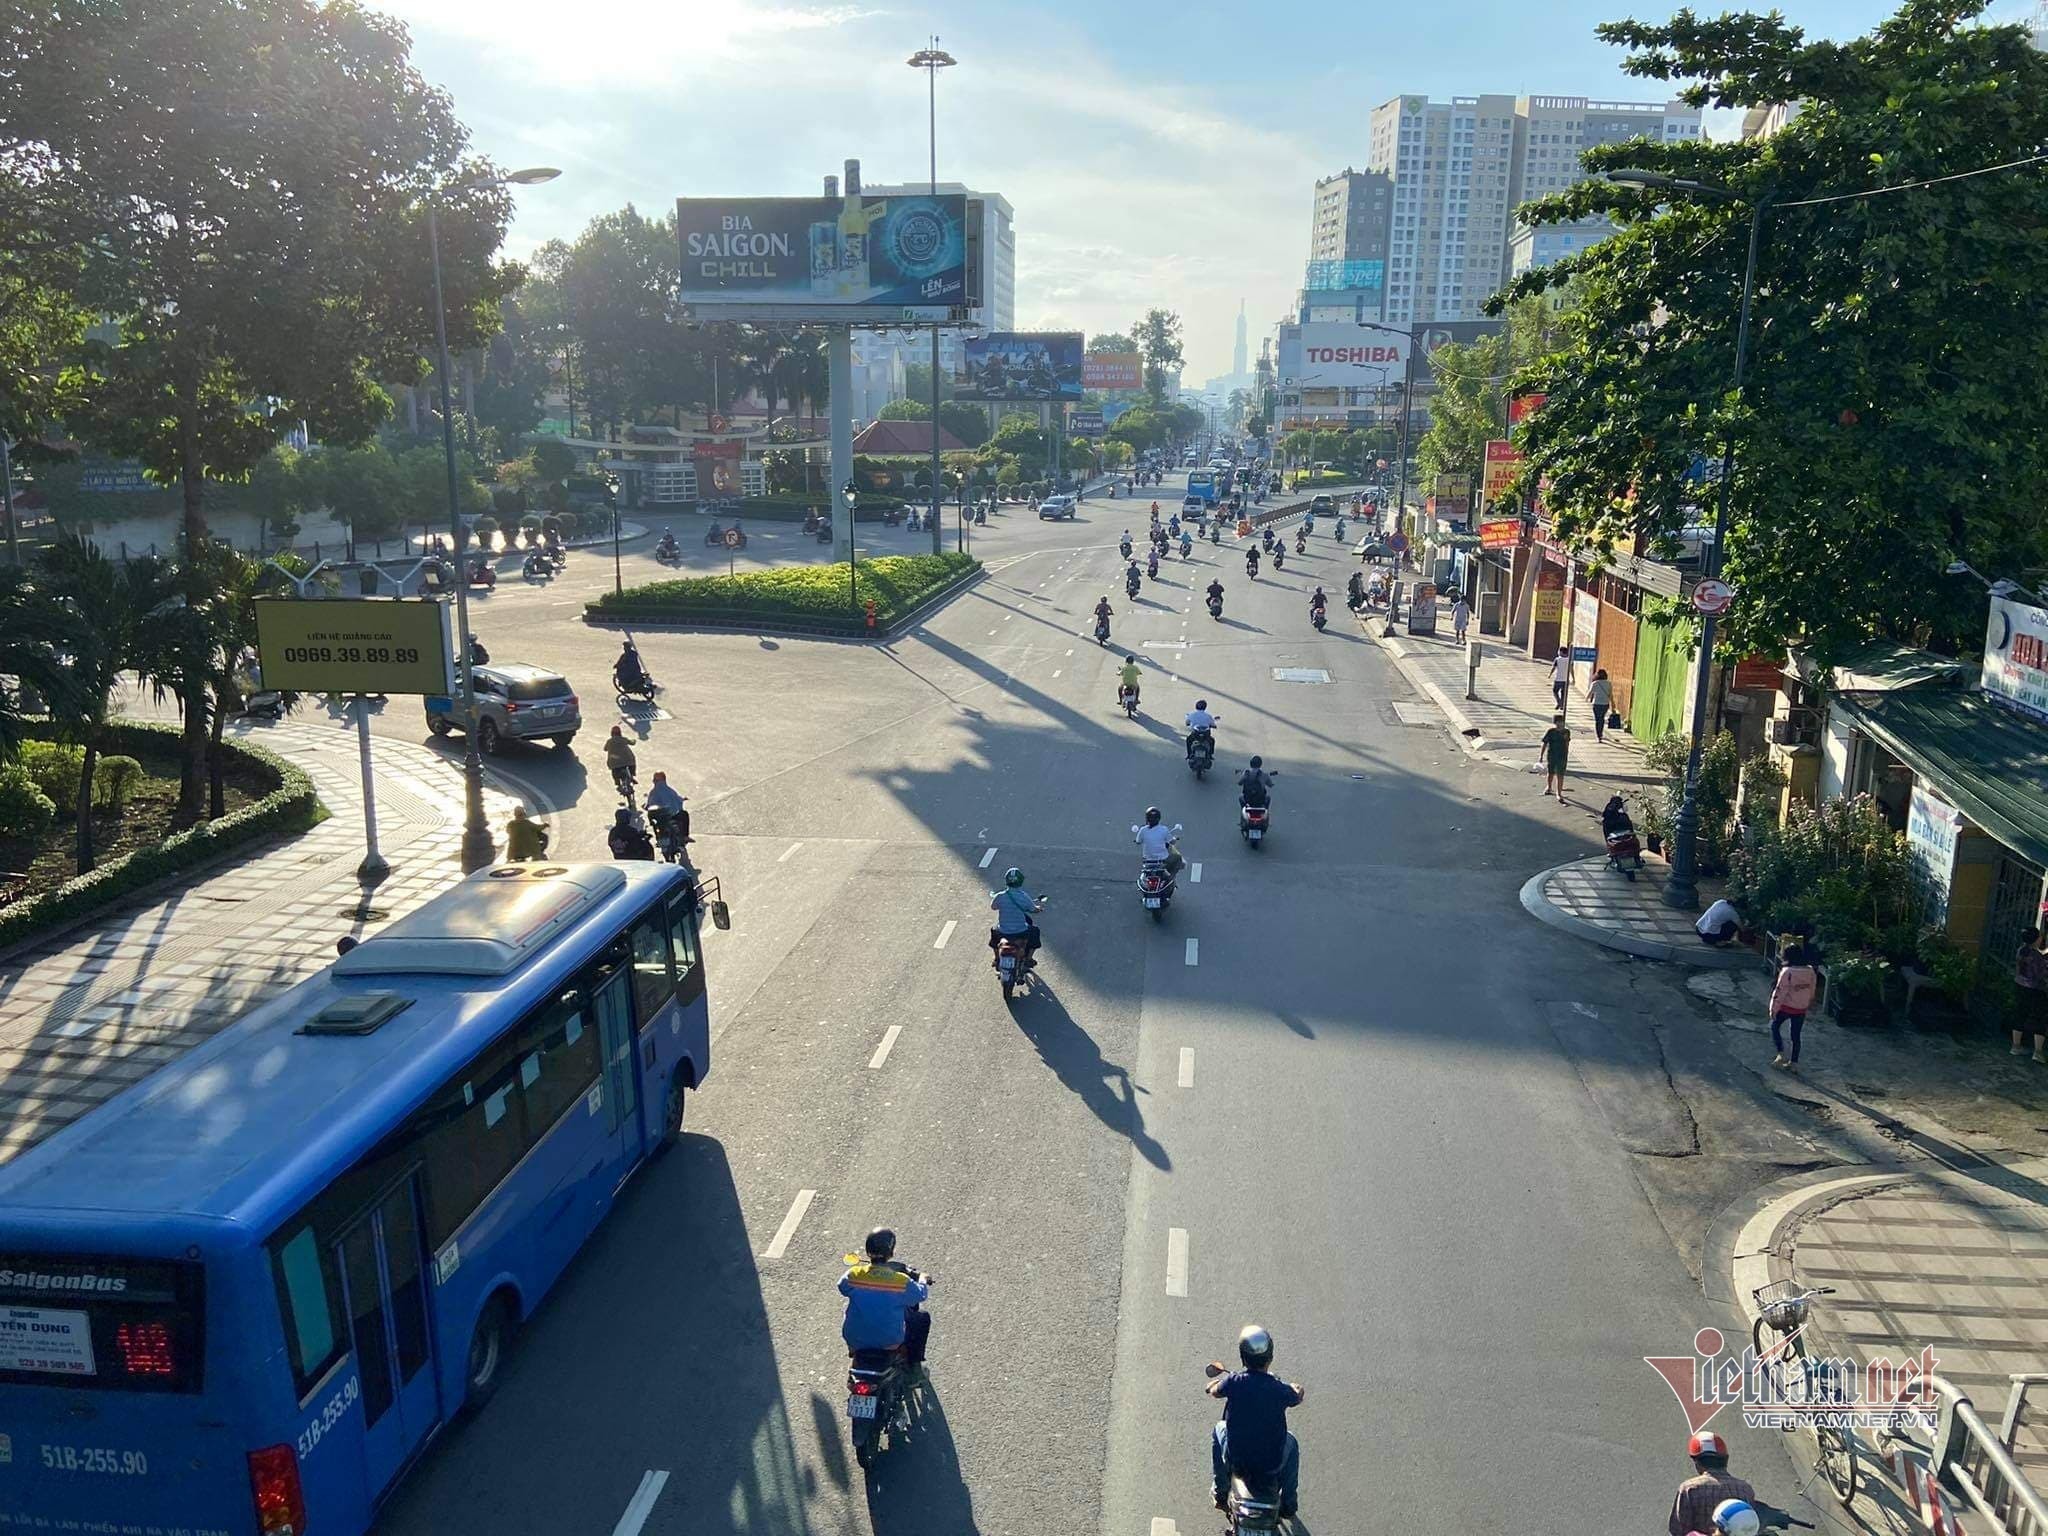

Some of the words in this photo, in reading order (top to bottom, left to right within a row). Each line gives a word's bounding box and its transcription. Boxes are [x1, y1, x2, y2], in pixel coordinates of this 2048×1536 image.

[721, 214, 753, 231] BIA
[687, 231, 790, 257] SAIGON
[701, 261, 777, 278] CHILL
[1307, 346, 1400, 363] TOSHIBA
[307, 631, 327, 641] LIÊN
[329, 631, 341, 641] HỆ
[342, 631, 371, 641] QUẢNG
[373, 631, 392, 641] CÁO
[285, 647, 419, 664] 0969.39.89.89
[0, 1269, 127, 1291] SaigonBus
[298, 1375, 359, 1460] 51B-255.90
[41, 1444, 148, 1475] 51B-255.90
